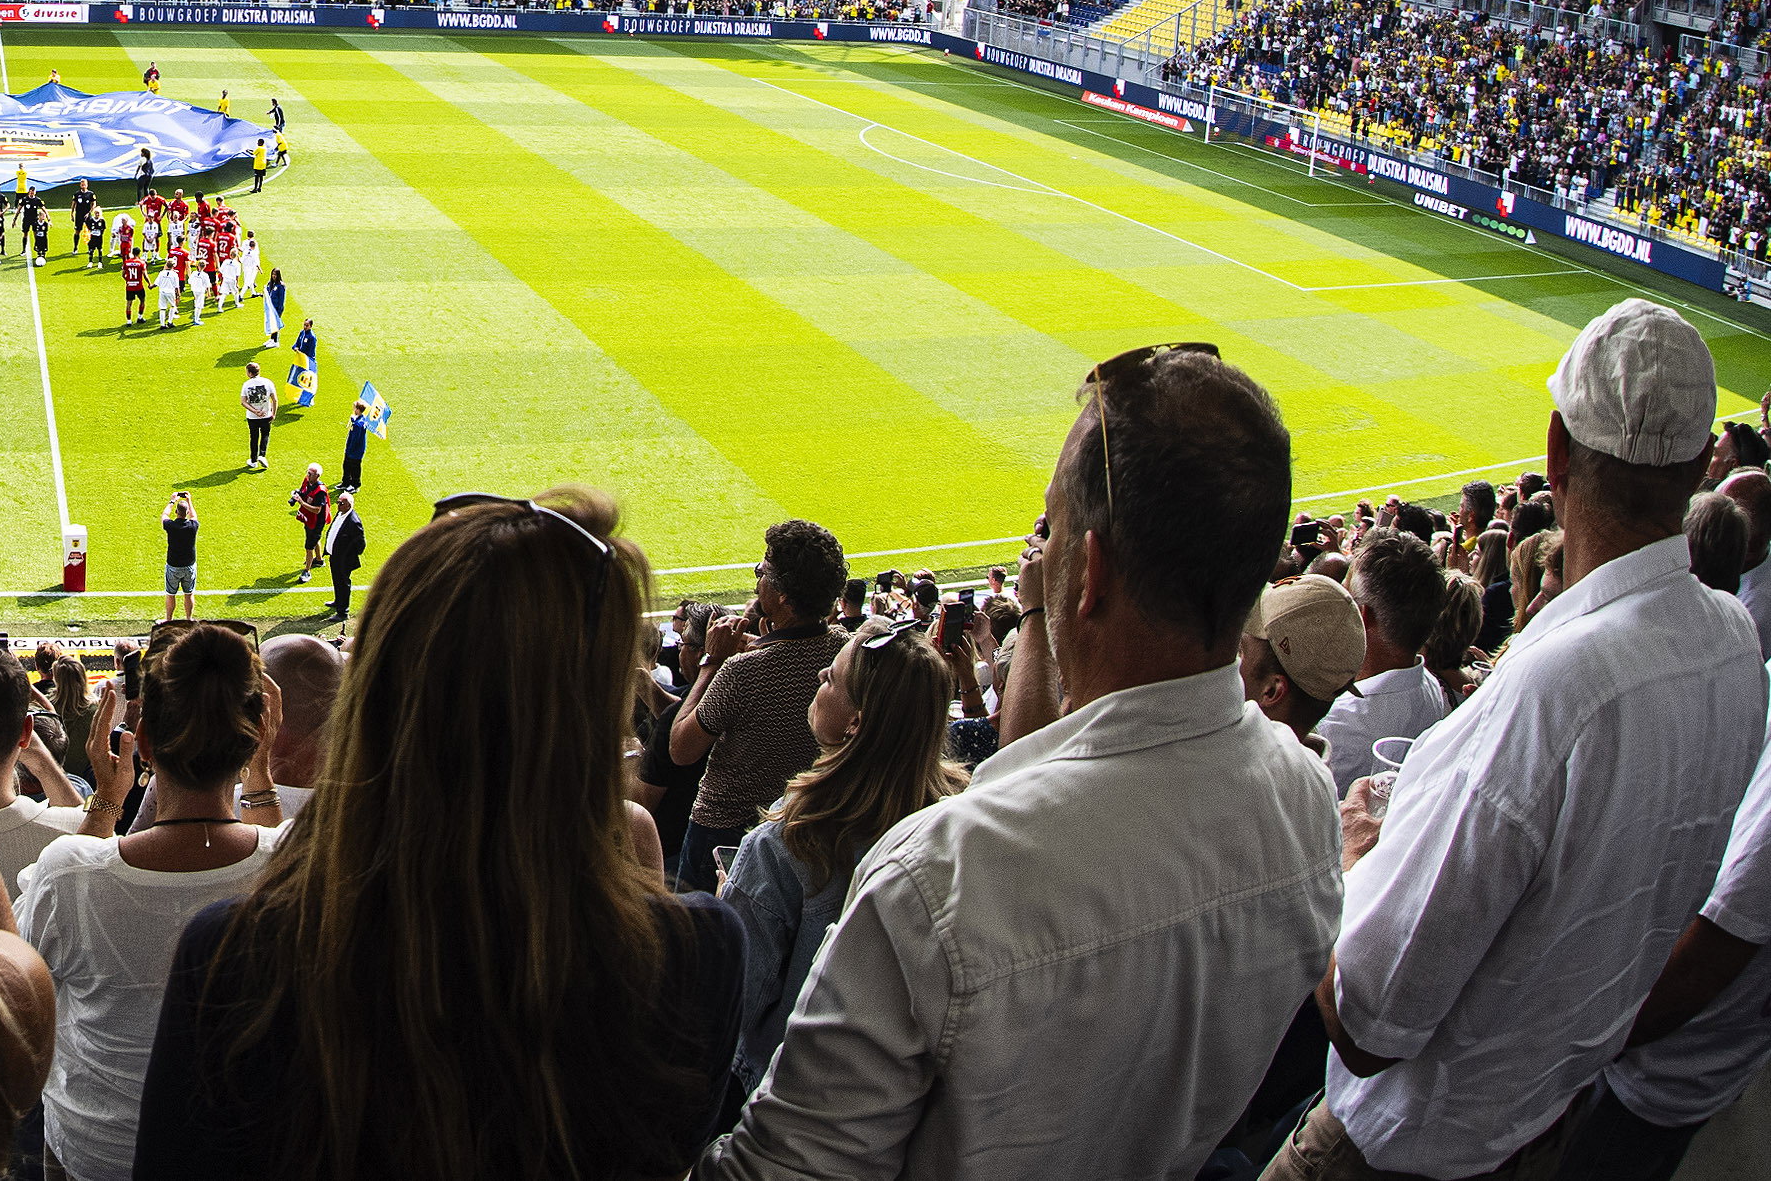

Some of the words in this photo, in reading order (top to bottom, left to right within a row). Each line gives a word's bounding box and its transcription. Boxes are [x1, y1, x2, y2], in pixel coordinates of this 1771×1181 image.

[33, 9, 78, 18] divisie
[139, 7, 218, 22] BOUWGROEP
[222, 9, 268, 24] DIJKSTRA
[270, 10, 316, 24] DRAISMA
[437, 13, 518, 29] WWW.BGDD.NL
[624, 18, 691, 34] BOUWGROEP
[694, 20, 733, 35] DIJKSTRA
[734, 21, 771, 36] DRAISMA
[870, 27, 932, 45] WWW.BGDD.NL
[986, 46, 1028, 70] BOUWGROEP
[1088, 92, 1126, 111] Keuken
[1126, 102, 1179, 128] Kampioen
[1367, 153, 1406, 184] DIJKSTRA
[1407, 166, 1449, 196] DRAISMA
[1413, 192, 1469, 220] UNIBET
[1565, 214, 1653, 264] WWW.BGDD.NL
[128, 267, 138, 280] 14
